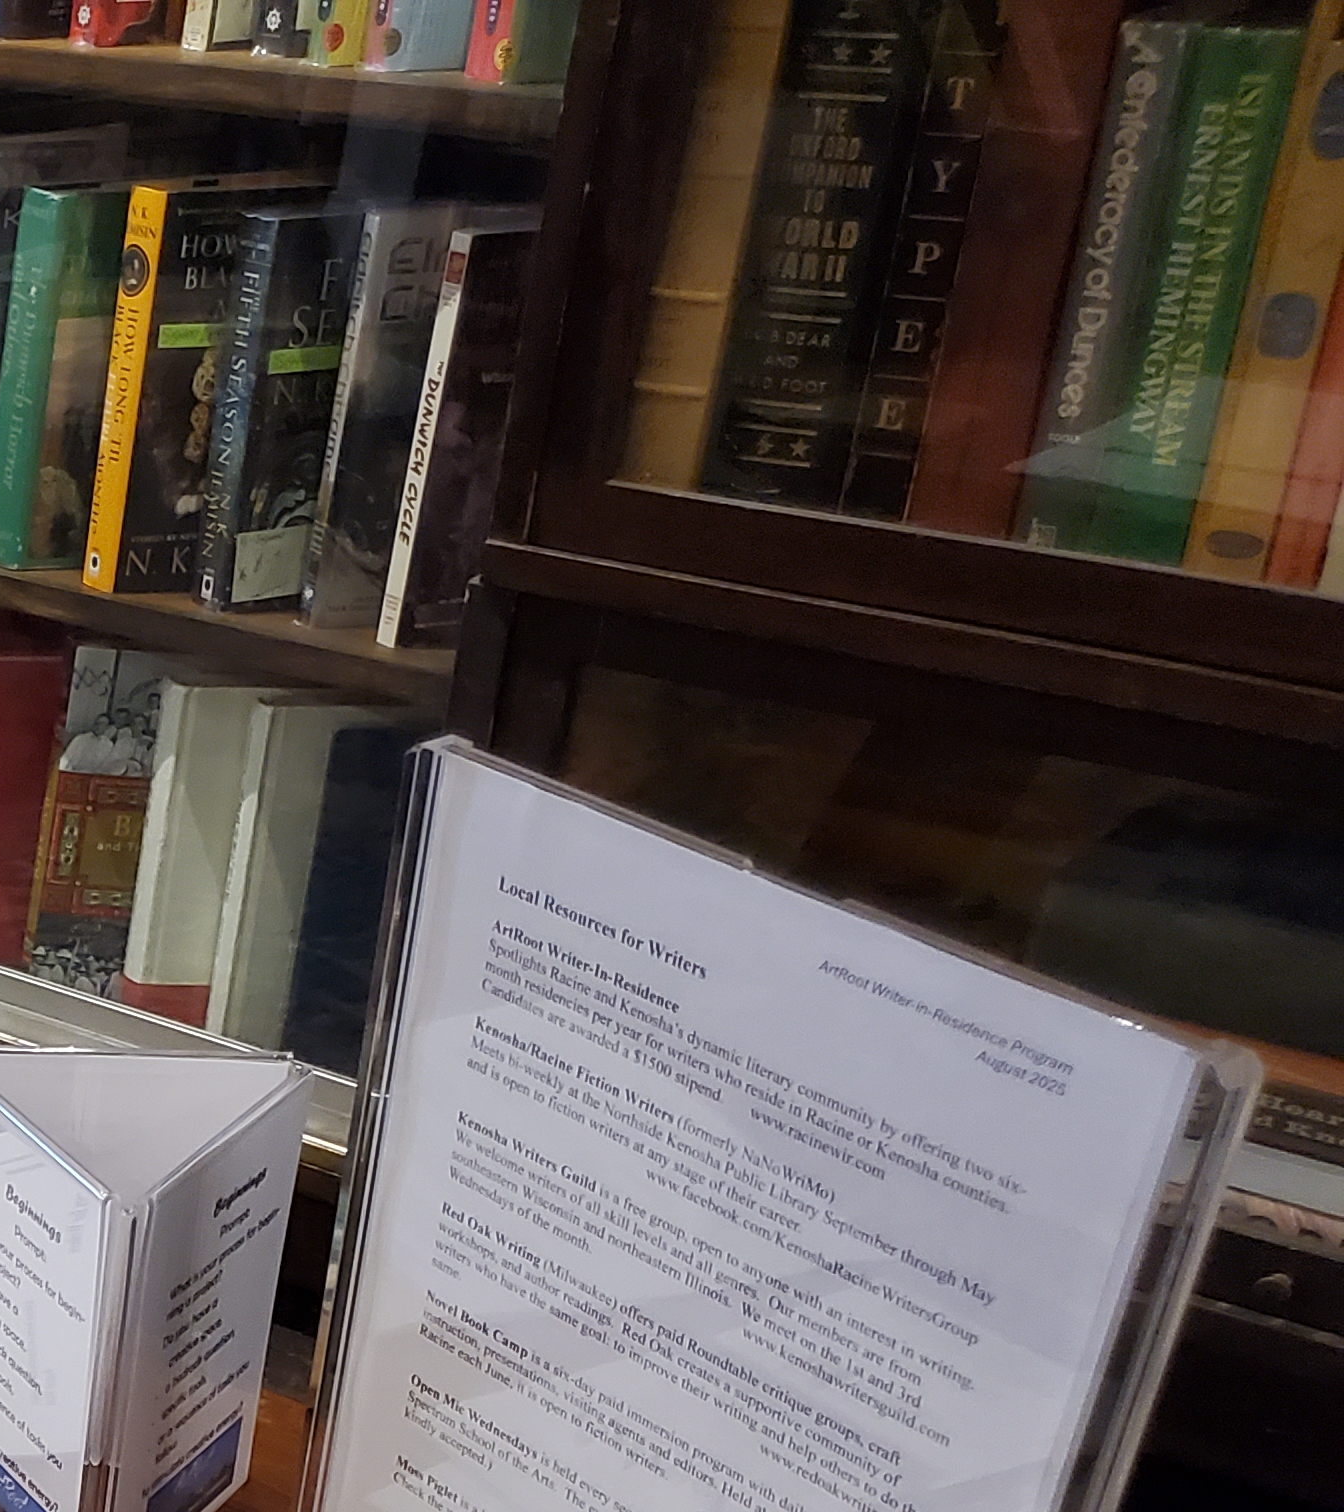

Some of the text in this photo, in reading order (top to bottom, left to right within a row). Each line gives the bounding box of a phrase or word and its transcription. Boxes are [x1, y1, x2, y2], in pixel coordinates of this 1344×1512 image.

[813, 105, 849, 133] THE
[1085, 67, 1159, 266] Confederacy
[783, 217, 861, 250] ORLD
[803, 188, 826, 214] TO
[1081, 268, 1114, 301] of
[1128, 102, 1230, 442] ERNEST HEMINGWAY
[1150, 71, 1272, 467] ISLANDS IN THE STREAM
[123, 306, 140, 361] HOW
[216, 271, 261, 467] FIFTH SEASON
[1056, 306, 1110, 420] Dunces
[114, 367, 131, 424] LONG
[409, 377, 441, 477] DUNWICH
[397, 482, 420, 547] CYCLE
[490, 918, 680, 1014] ArtRoot Writer-In-Residence
[498, 874, 706, 979] Local Resources for Writers
[817, 958, 1074, 1076] ArtRoot Writer-in-Residence Program
[474, 1014, 574, 1075] Kenosha/Racine
[575, 1064, 620, 1098] Fiction
[624, 1086, 675, 1124] Writers
[675, 1115, 736, 1157] (formerly
[973, 1049, 1067, 1097] August 2025
[749, 1107, 886, 1181] www.racinewir.com
[4, 1182, 62, 1244] Beginnings
[742, 1326, 950, 1447] www.kenoshawritersguild.com
